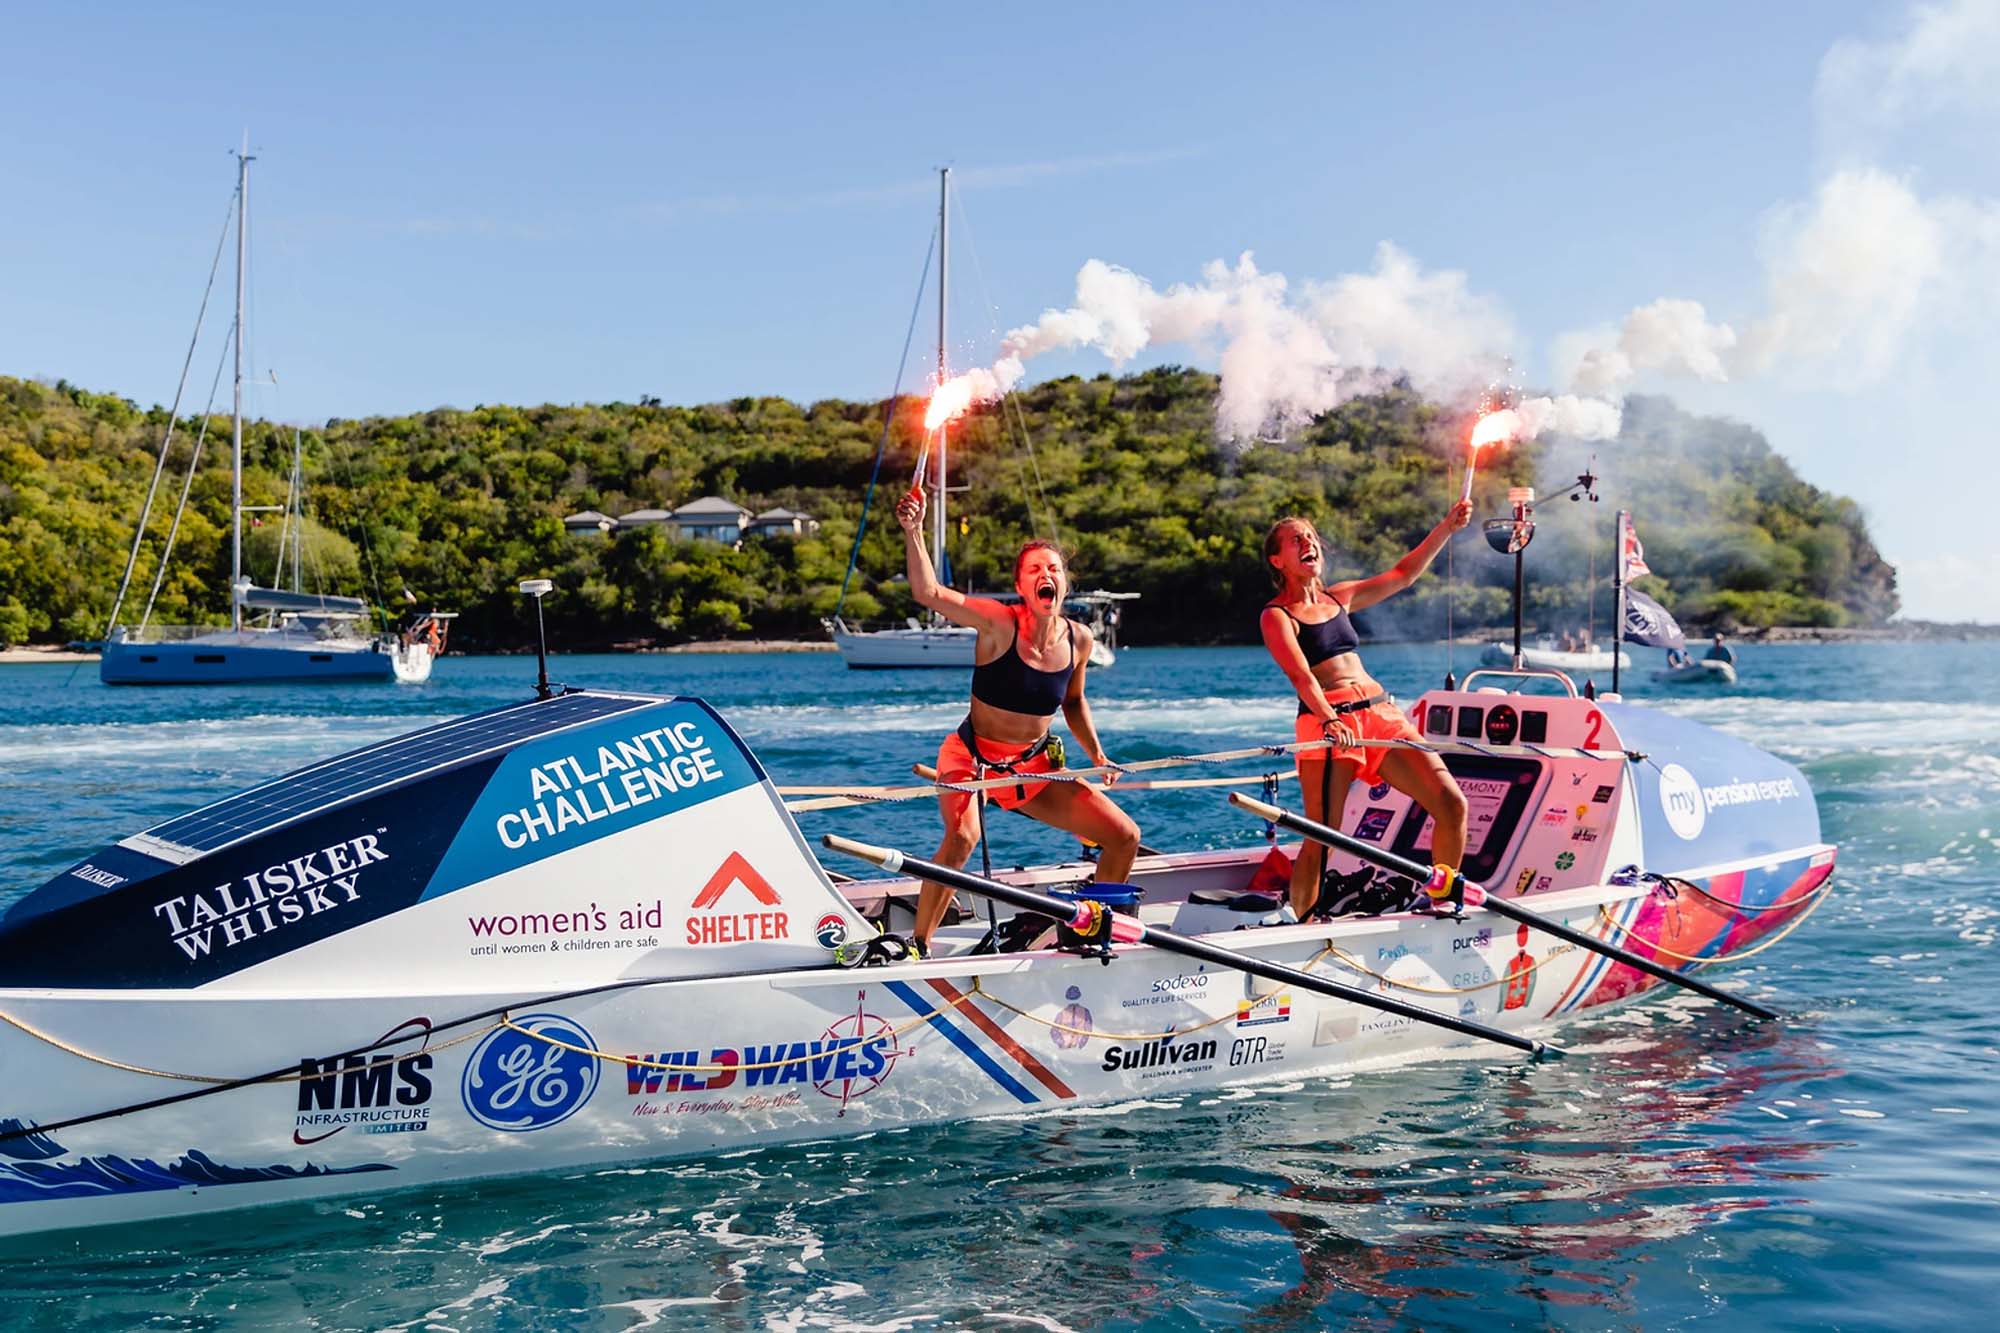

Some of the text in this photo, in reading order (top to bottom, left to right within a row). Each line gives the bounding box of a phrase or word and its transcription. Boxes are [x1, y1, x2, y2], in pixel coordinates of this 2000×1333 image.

[1412, 700, 1602, 750] 1 2
[529, 721, 704, 800] ATLANTIC
[496, 747, 724, 849] CHALLENGE
[1668, 792, 1696, 814] my
[154, 833, 389, 937] TALISKER
[173, 872, 361, 961] WHISKY
[468, 899, 662, 937] women's aid
[686, 911, 790, 945] SHELTER
[470, 935, 659, 956] until women & children are safe
[858, 989, 866, 1001] N
[1151, 972, 1209, 993] sodexo
[1122, 997, 1150, 1008] QUALITY
[1151, 995, 1161, 1005] OF
[1161, 994, 1175, 1004] LIFE
[626, 1034, 888, 1095] WILD WAVES
[908, 1046, 916, 1057] E
[1101, 1040, 1217, 1072] Sullivan
[1229, 1036, 1267, 1067] GTR
[298, 1053, 433, 1112] NMS
[296, 1107, 431, 1126] INFRASTRUCTURE
[361, 1122, 423, 1134] LIMITED
